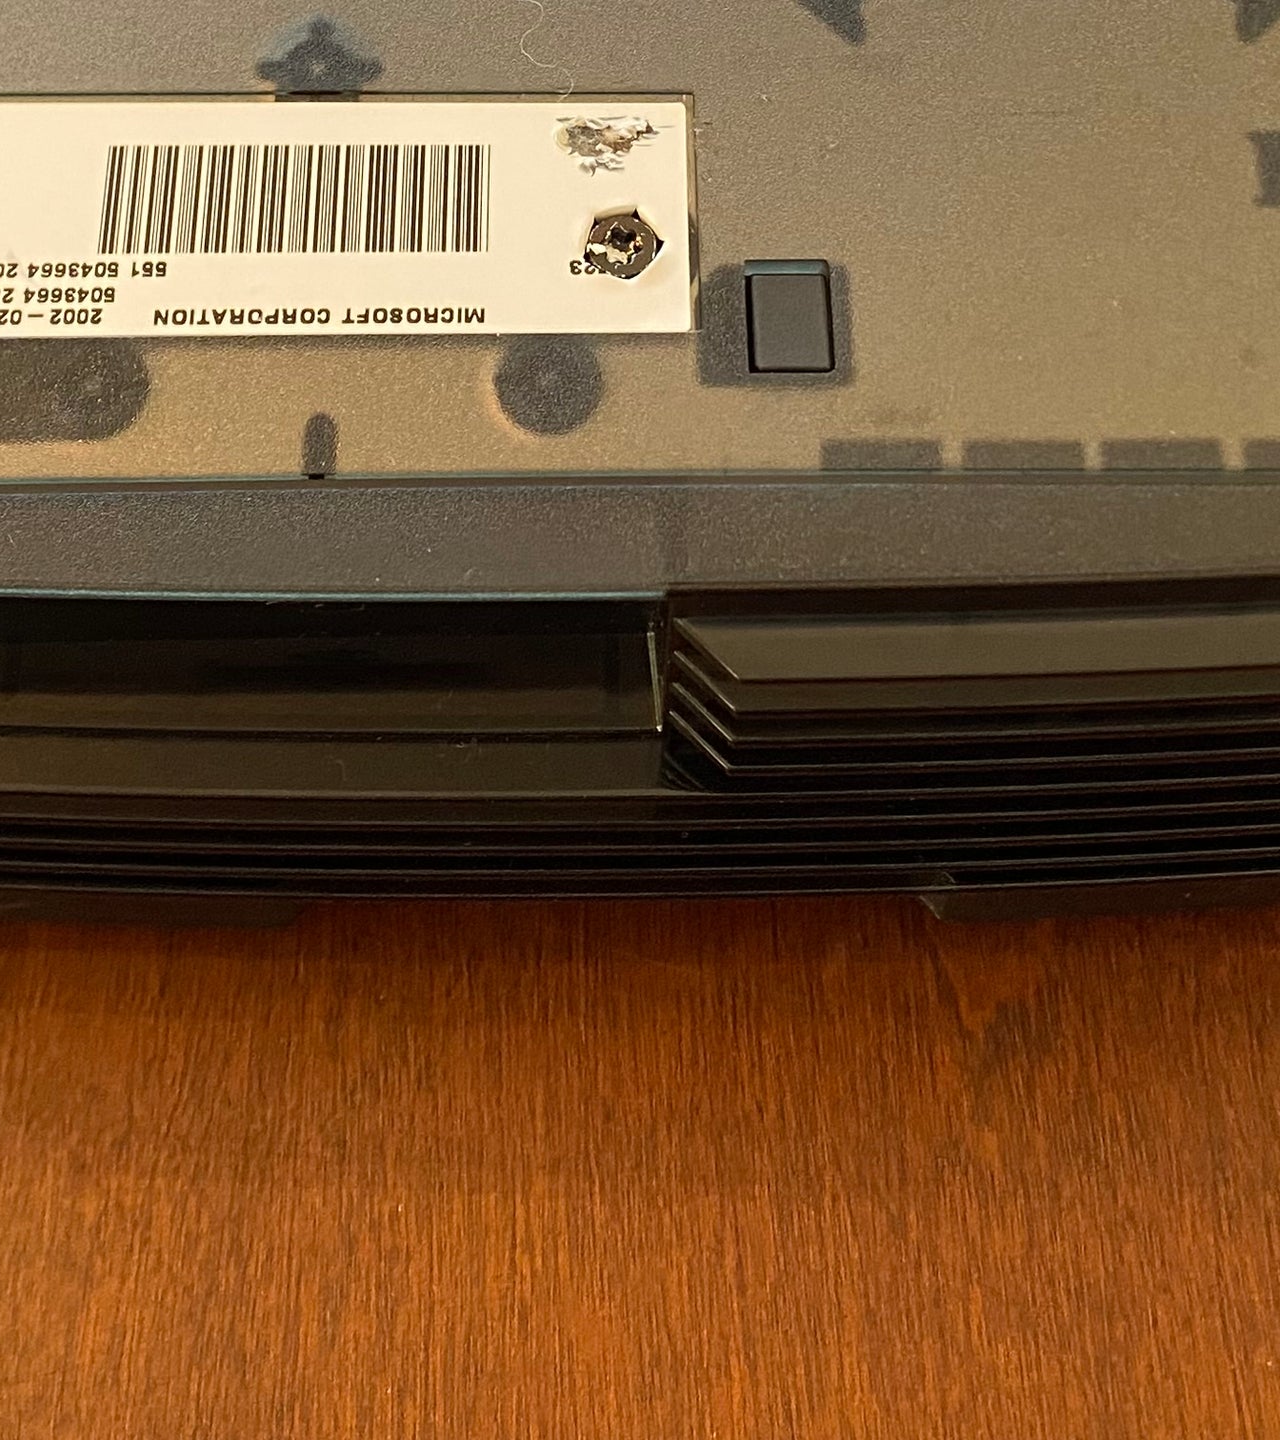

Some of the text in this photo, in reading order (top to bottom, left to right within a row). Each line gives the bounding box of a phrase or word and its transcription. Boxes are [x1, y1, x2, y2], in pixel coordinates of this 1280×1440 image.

[131, 261, 168, 278] 551
[153, 307, 331, 326] CORPORATION
[341, 307, 485, 325] MICROSOFT
